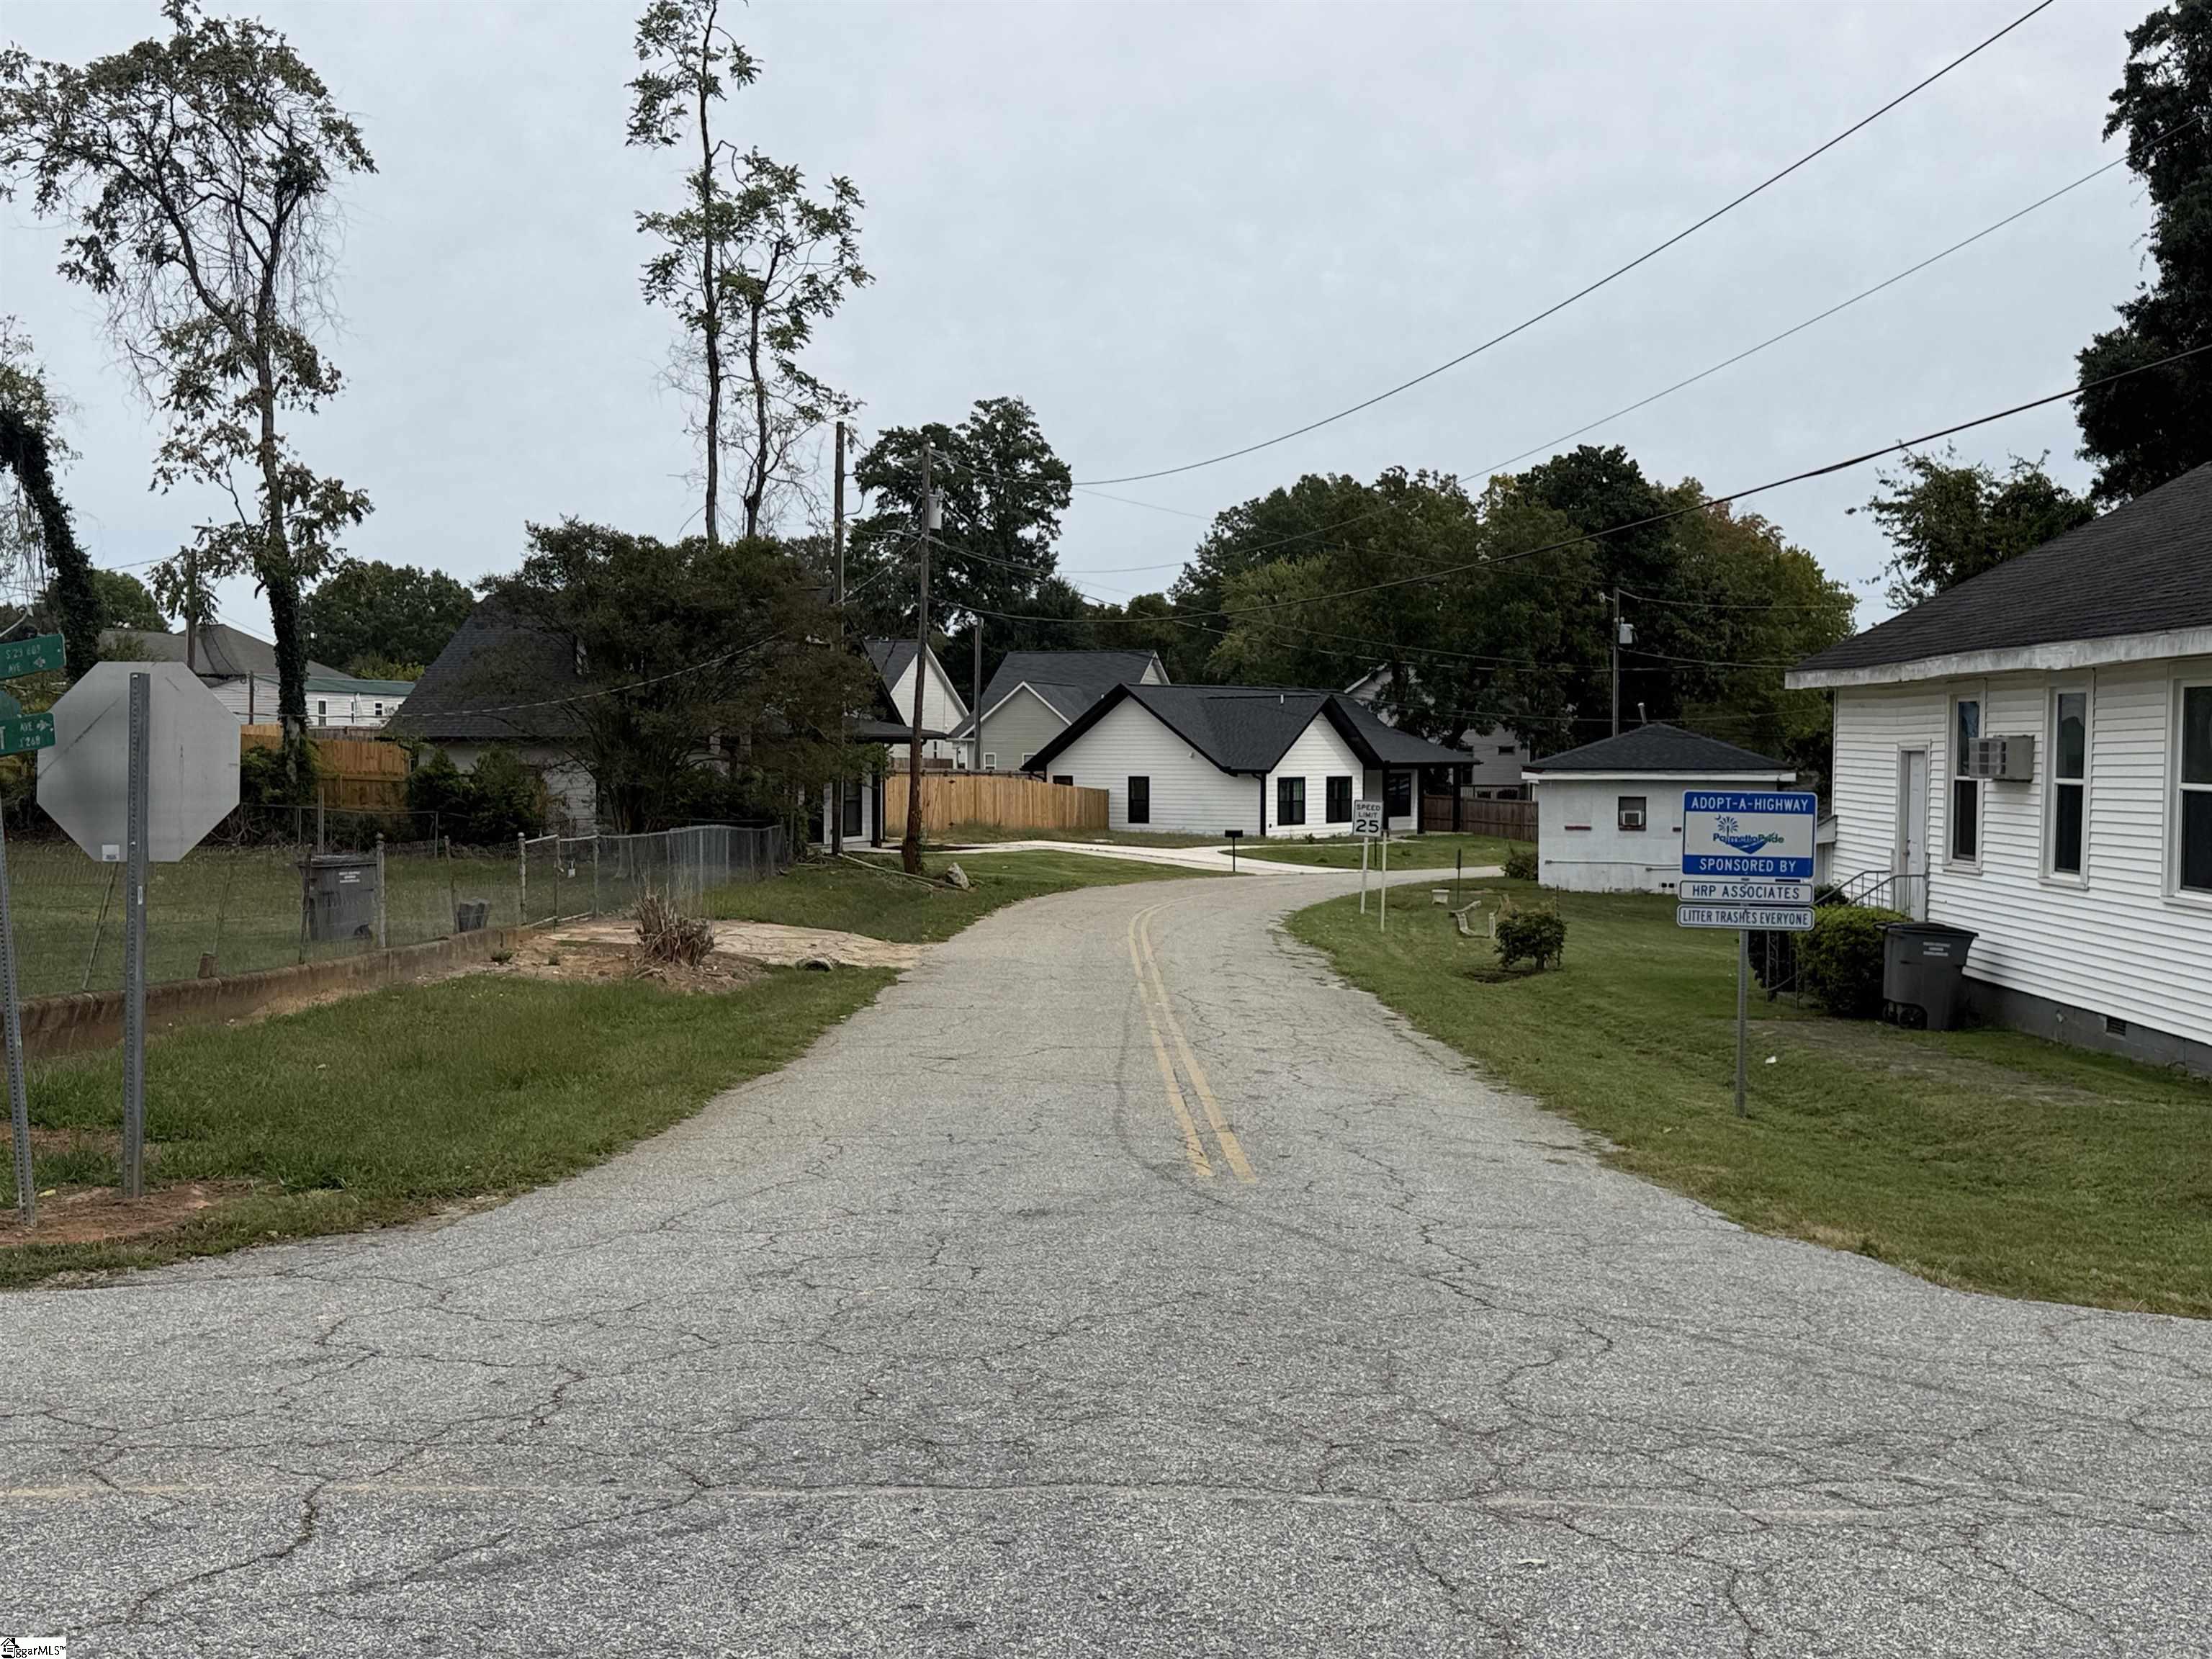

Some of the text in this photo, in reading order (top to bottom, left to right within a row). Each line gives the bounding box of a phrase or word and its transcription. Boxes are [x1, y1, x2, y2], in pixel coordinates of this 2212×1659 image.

[19, 721, 33, 732] AVE
[1691, 796, 1808, 811] ADOPT-A-HIGHWAY
[1355, 819, 1379, 833] 25
[1699, 858, 1797, 873] SPONSORED BY
[1692, 884, 1800, 899] HRP ASSOCIATES
[1683, 909, 1808, 926] LITTER TRASHES EVERYONE
